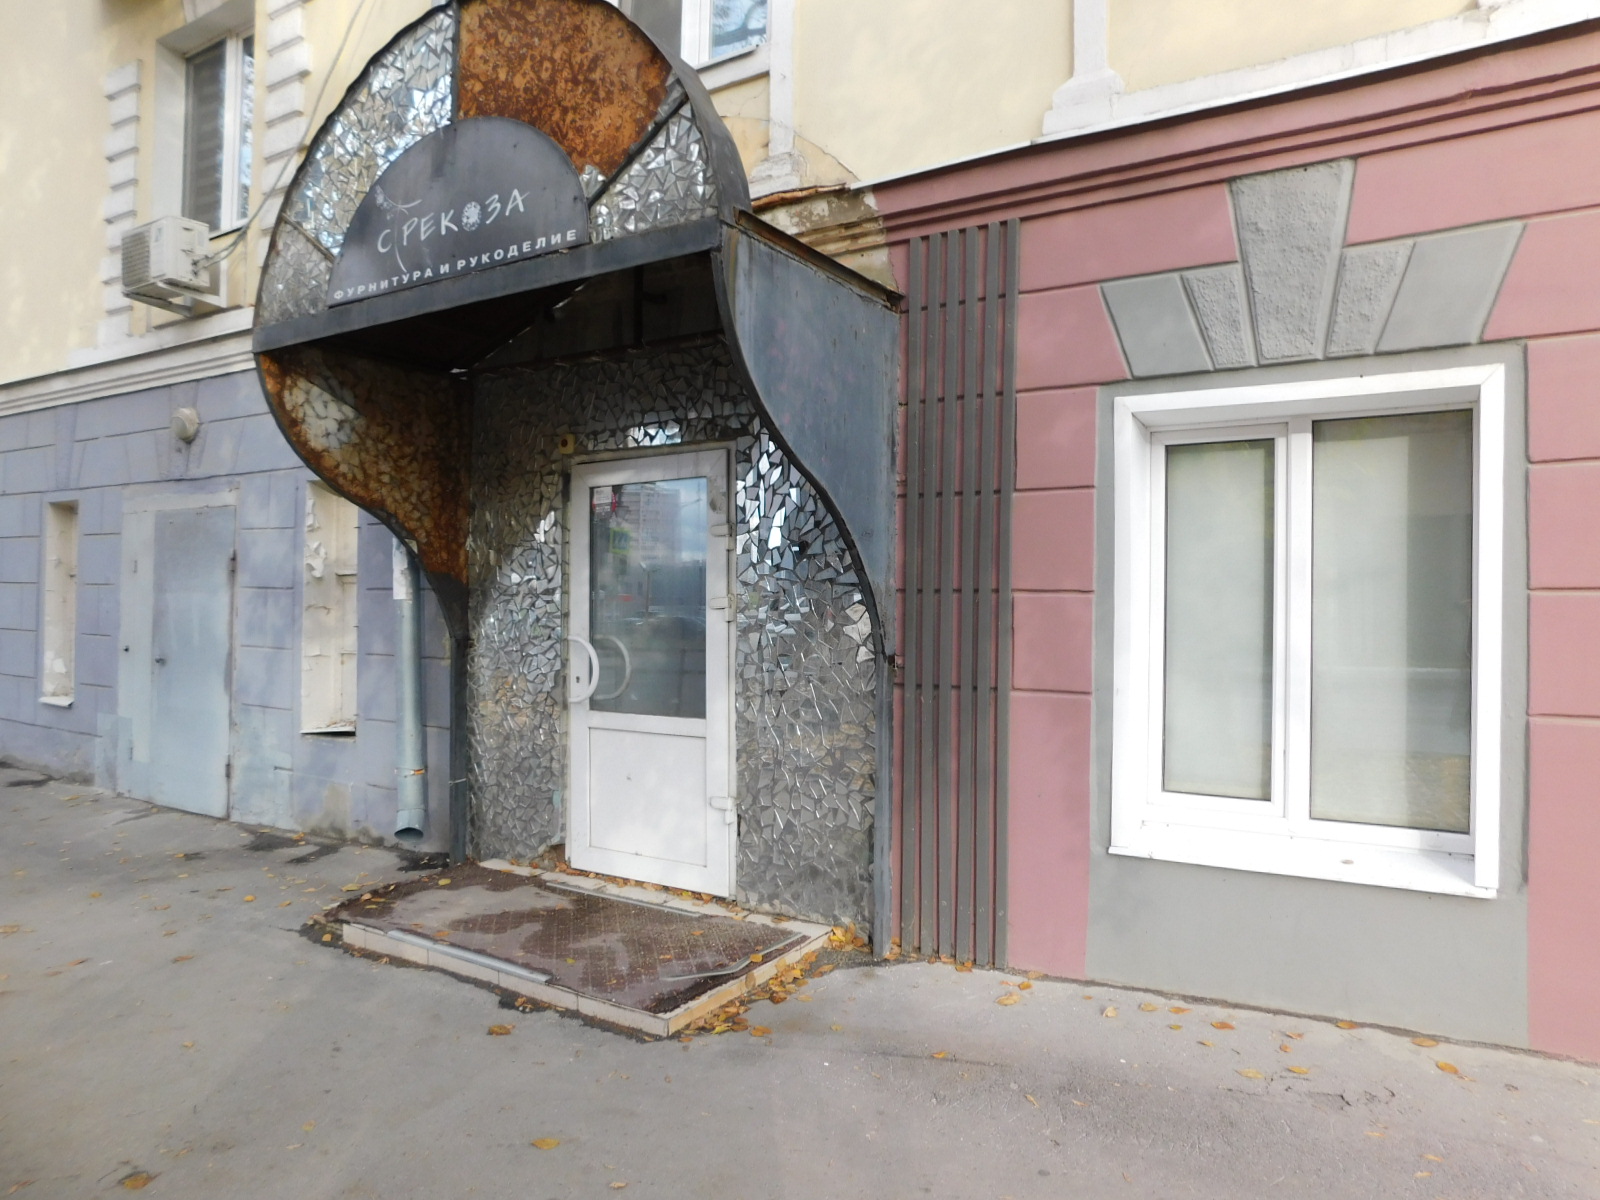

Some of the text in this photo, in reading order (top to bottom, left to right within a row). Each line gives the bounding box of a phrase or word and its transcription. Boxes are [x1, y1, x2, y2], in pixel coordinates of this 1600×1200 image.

[333, 229, 578, 300] ФУРНИТУРА И РУКОДЕЛИЕ
